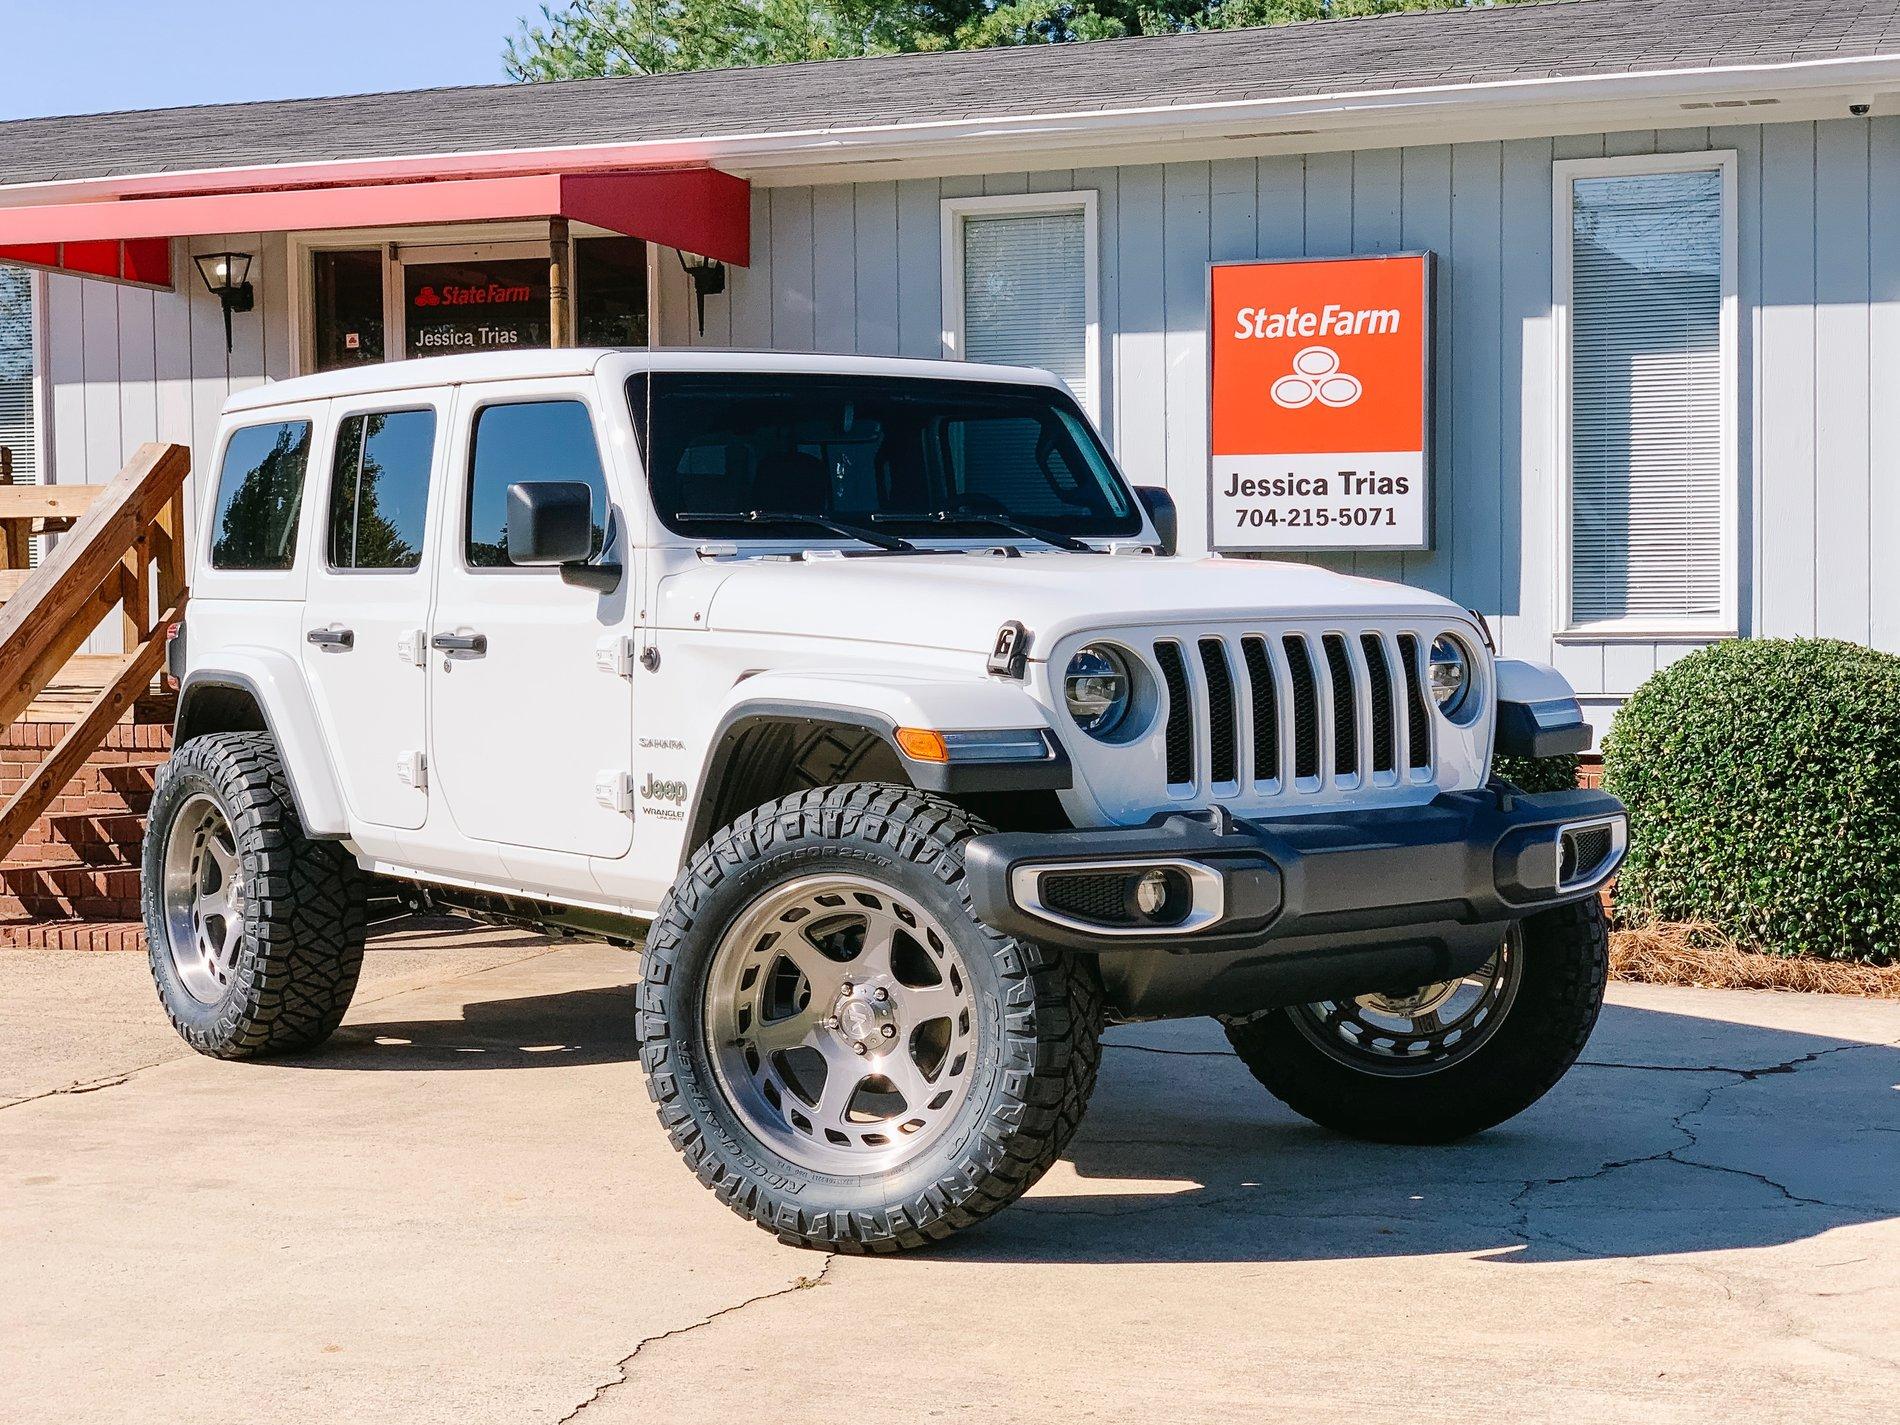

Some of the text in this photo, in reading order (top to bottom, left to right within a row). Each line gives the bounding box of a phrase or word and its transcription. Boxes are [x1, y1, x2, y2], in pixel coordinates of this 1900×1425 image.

[415, 327, 518, 347] Jessica Trias
[1224, 471, 1409, 497] Jessica Trias
[1235, 507, 1396, 527] 704-215-5071
[639, 738, 687, 751] SAHARA
[640, 772, 688, 806] Jeep
